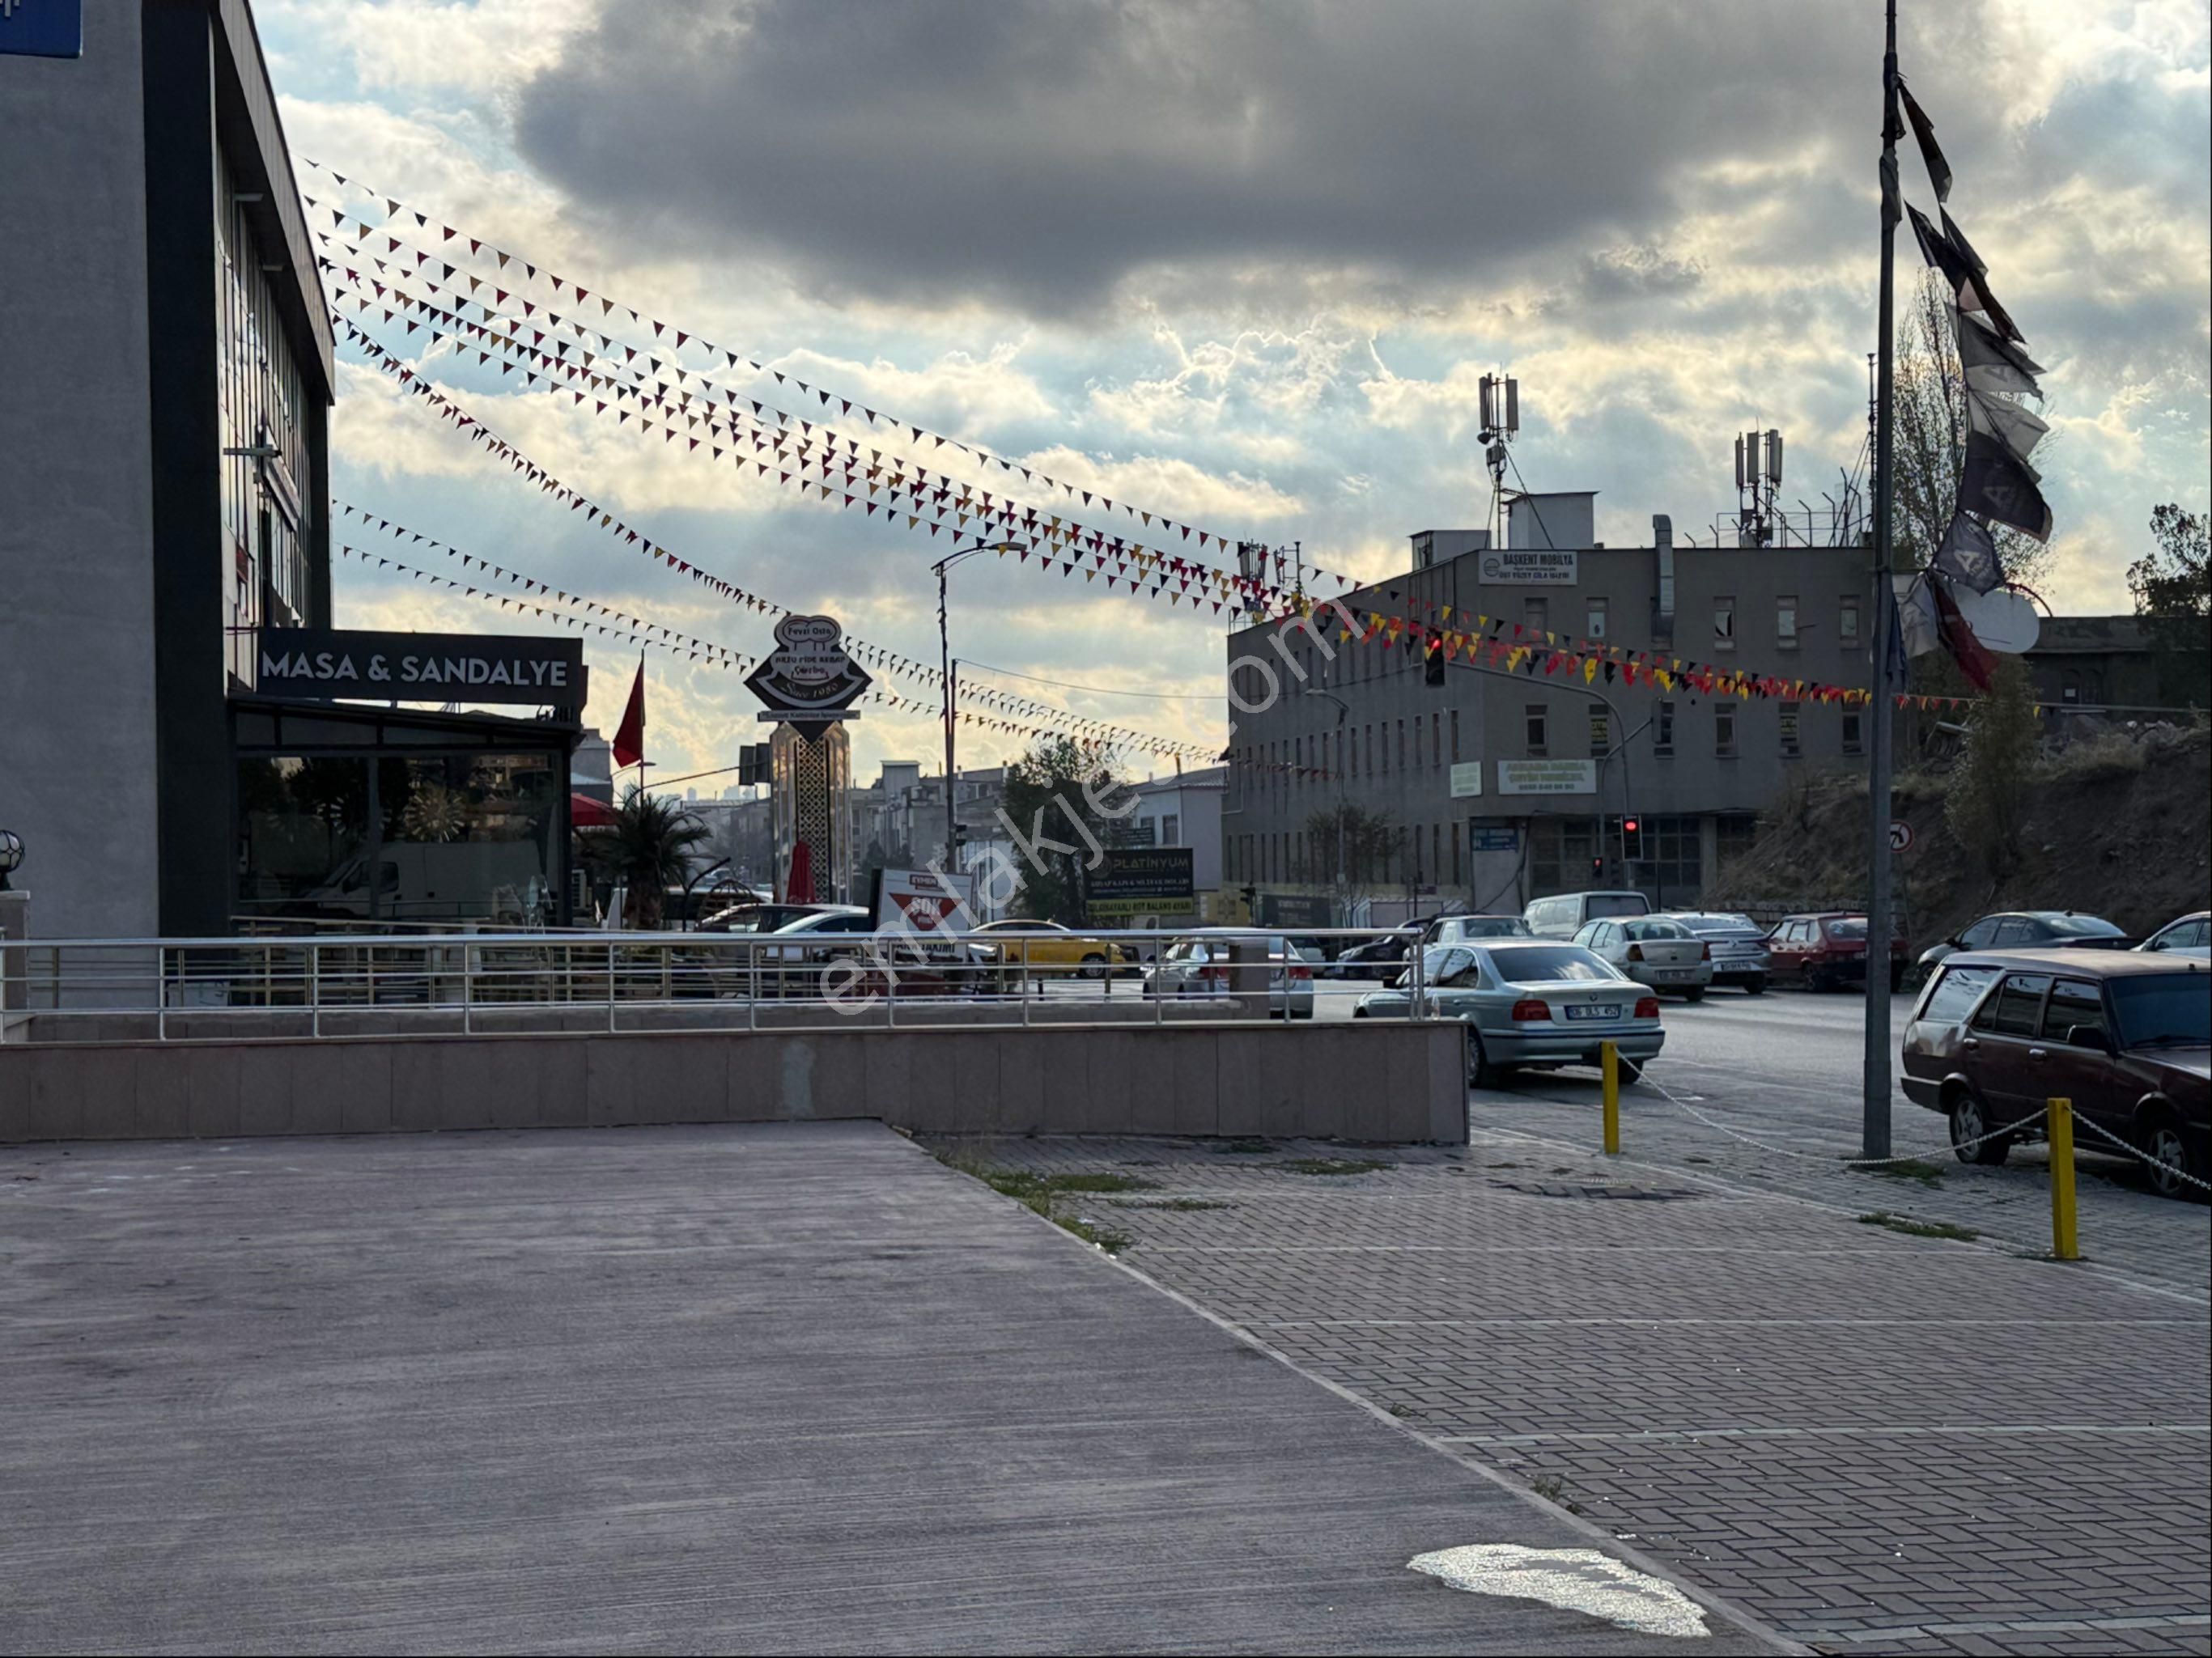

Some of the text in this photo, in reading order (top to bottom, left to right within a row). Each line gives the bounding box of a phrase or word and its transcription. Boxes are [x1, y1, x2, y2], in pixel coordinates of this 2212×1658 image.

[262, 651, 567, 686] MASA & SANDALYE
[1113, 857, 1189, 869] PLATİNYUM
